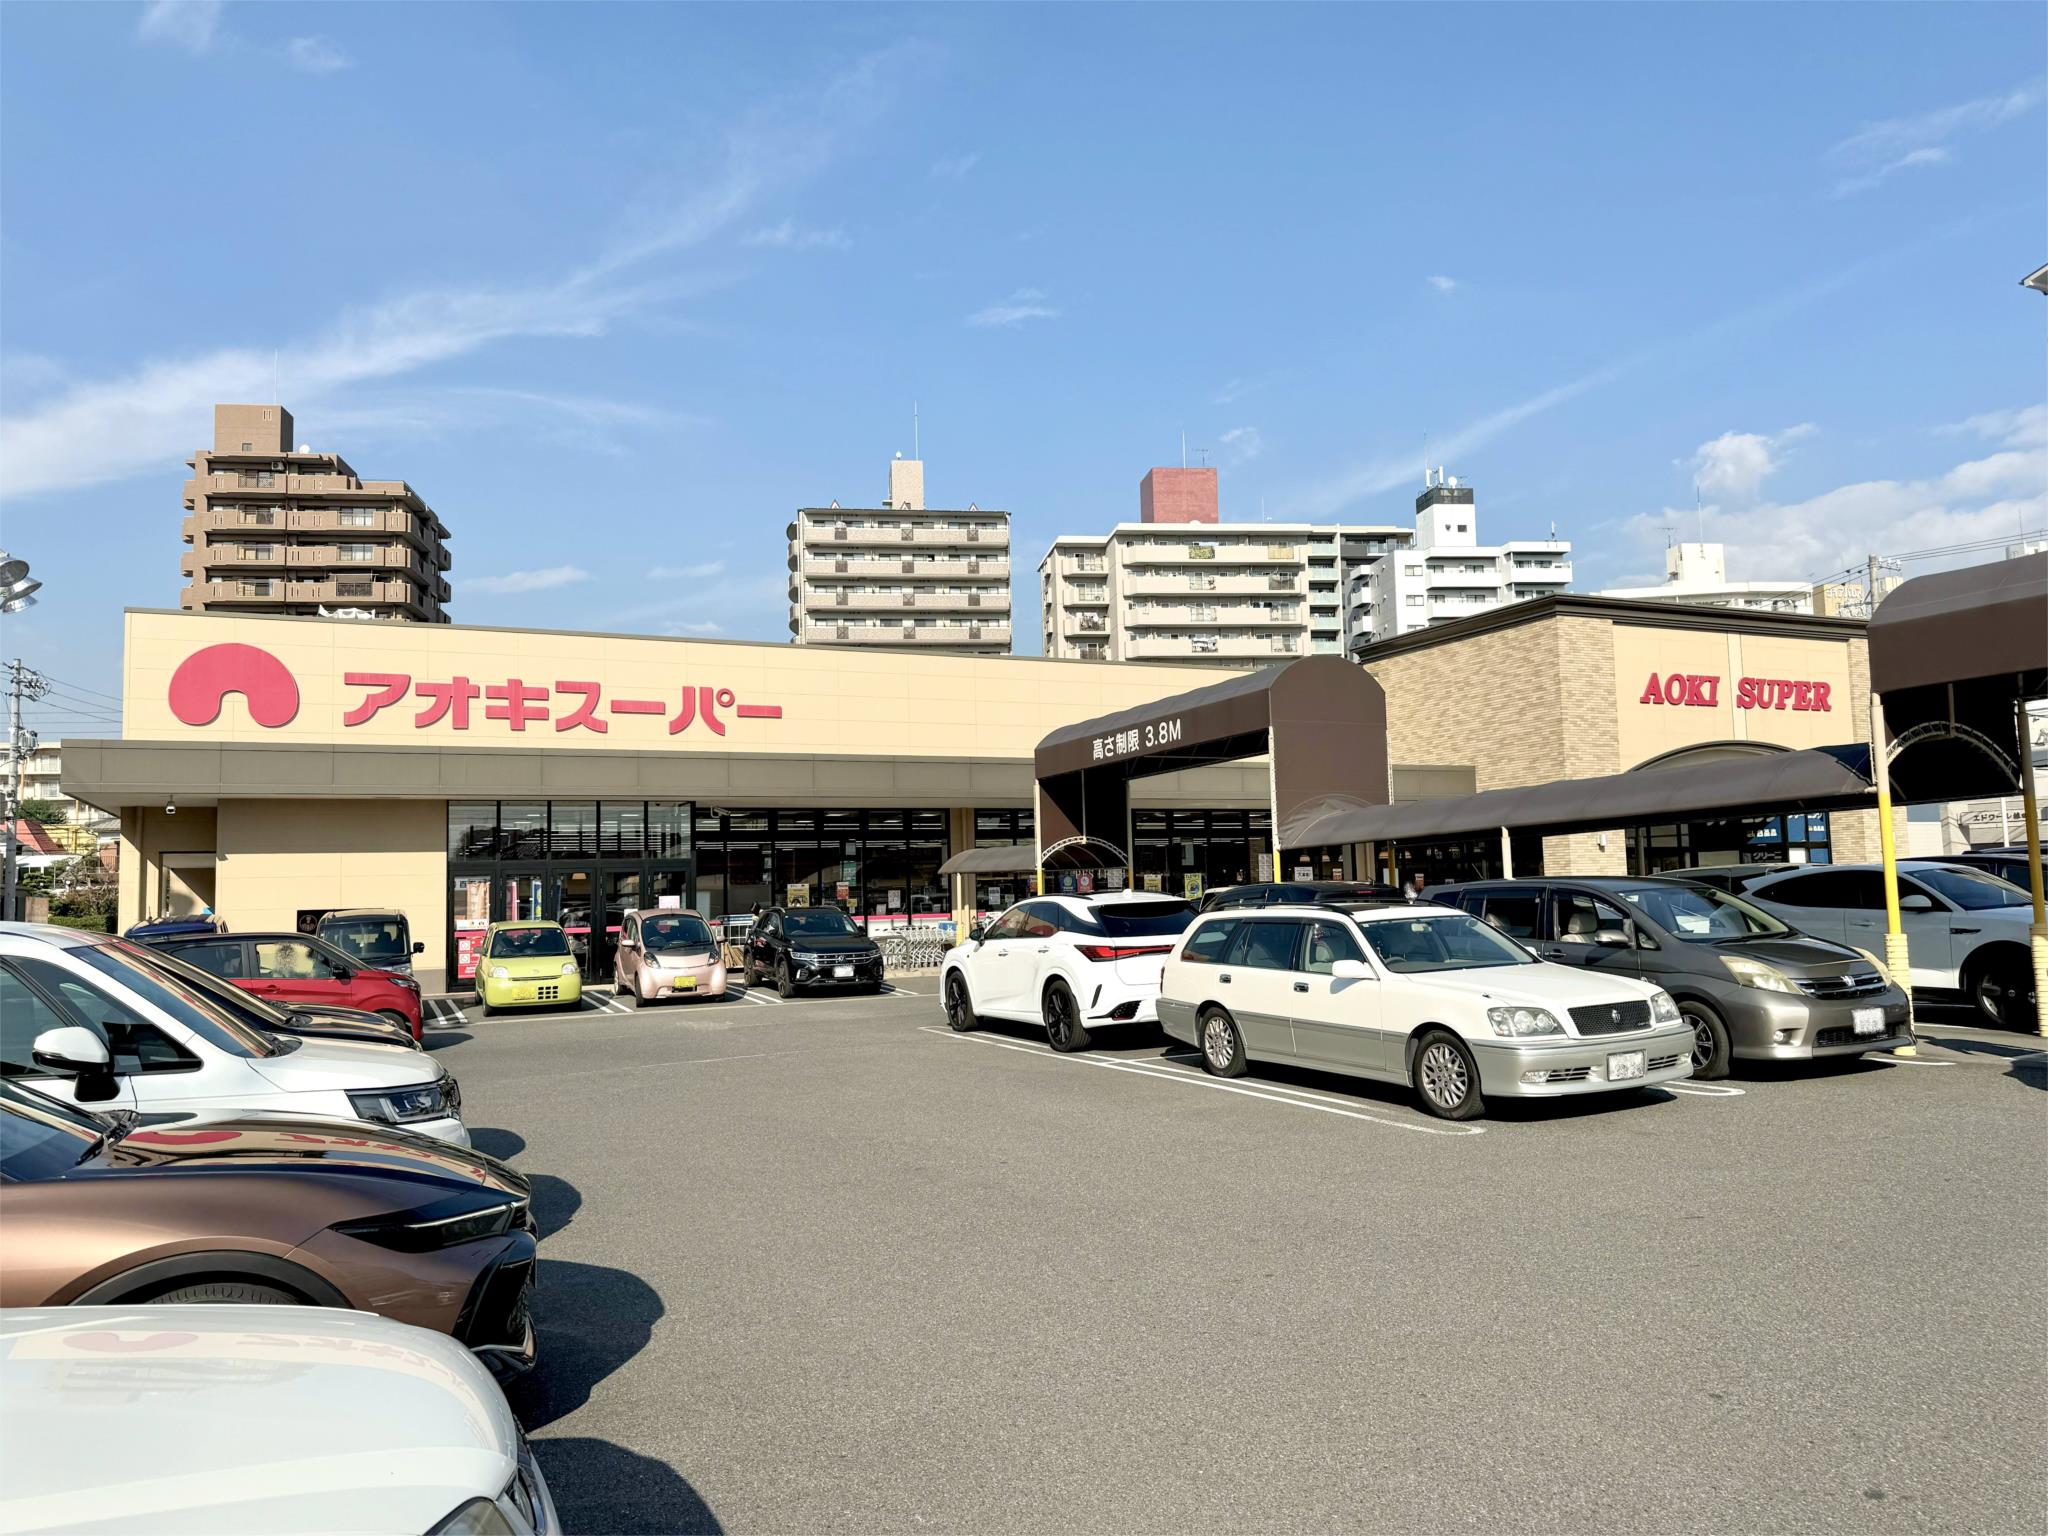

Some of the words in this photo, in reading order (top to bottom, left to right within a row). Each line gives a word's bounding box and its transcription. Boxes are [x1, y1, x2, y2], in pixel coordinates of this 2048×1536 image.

[344, 671, 782, 736] アオキスーパー
[1640, 672, 1720, 707] AOKI
[1736, 676, 1832, 712] SUPER
[1092, 729, 1139, 761] 高さ制限
[1145, 718, 1181, 748] 3.8M
